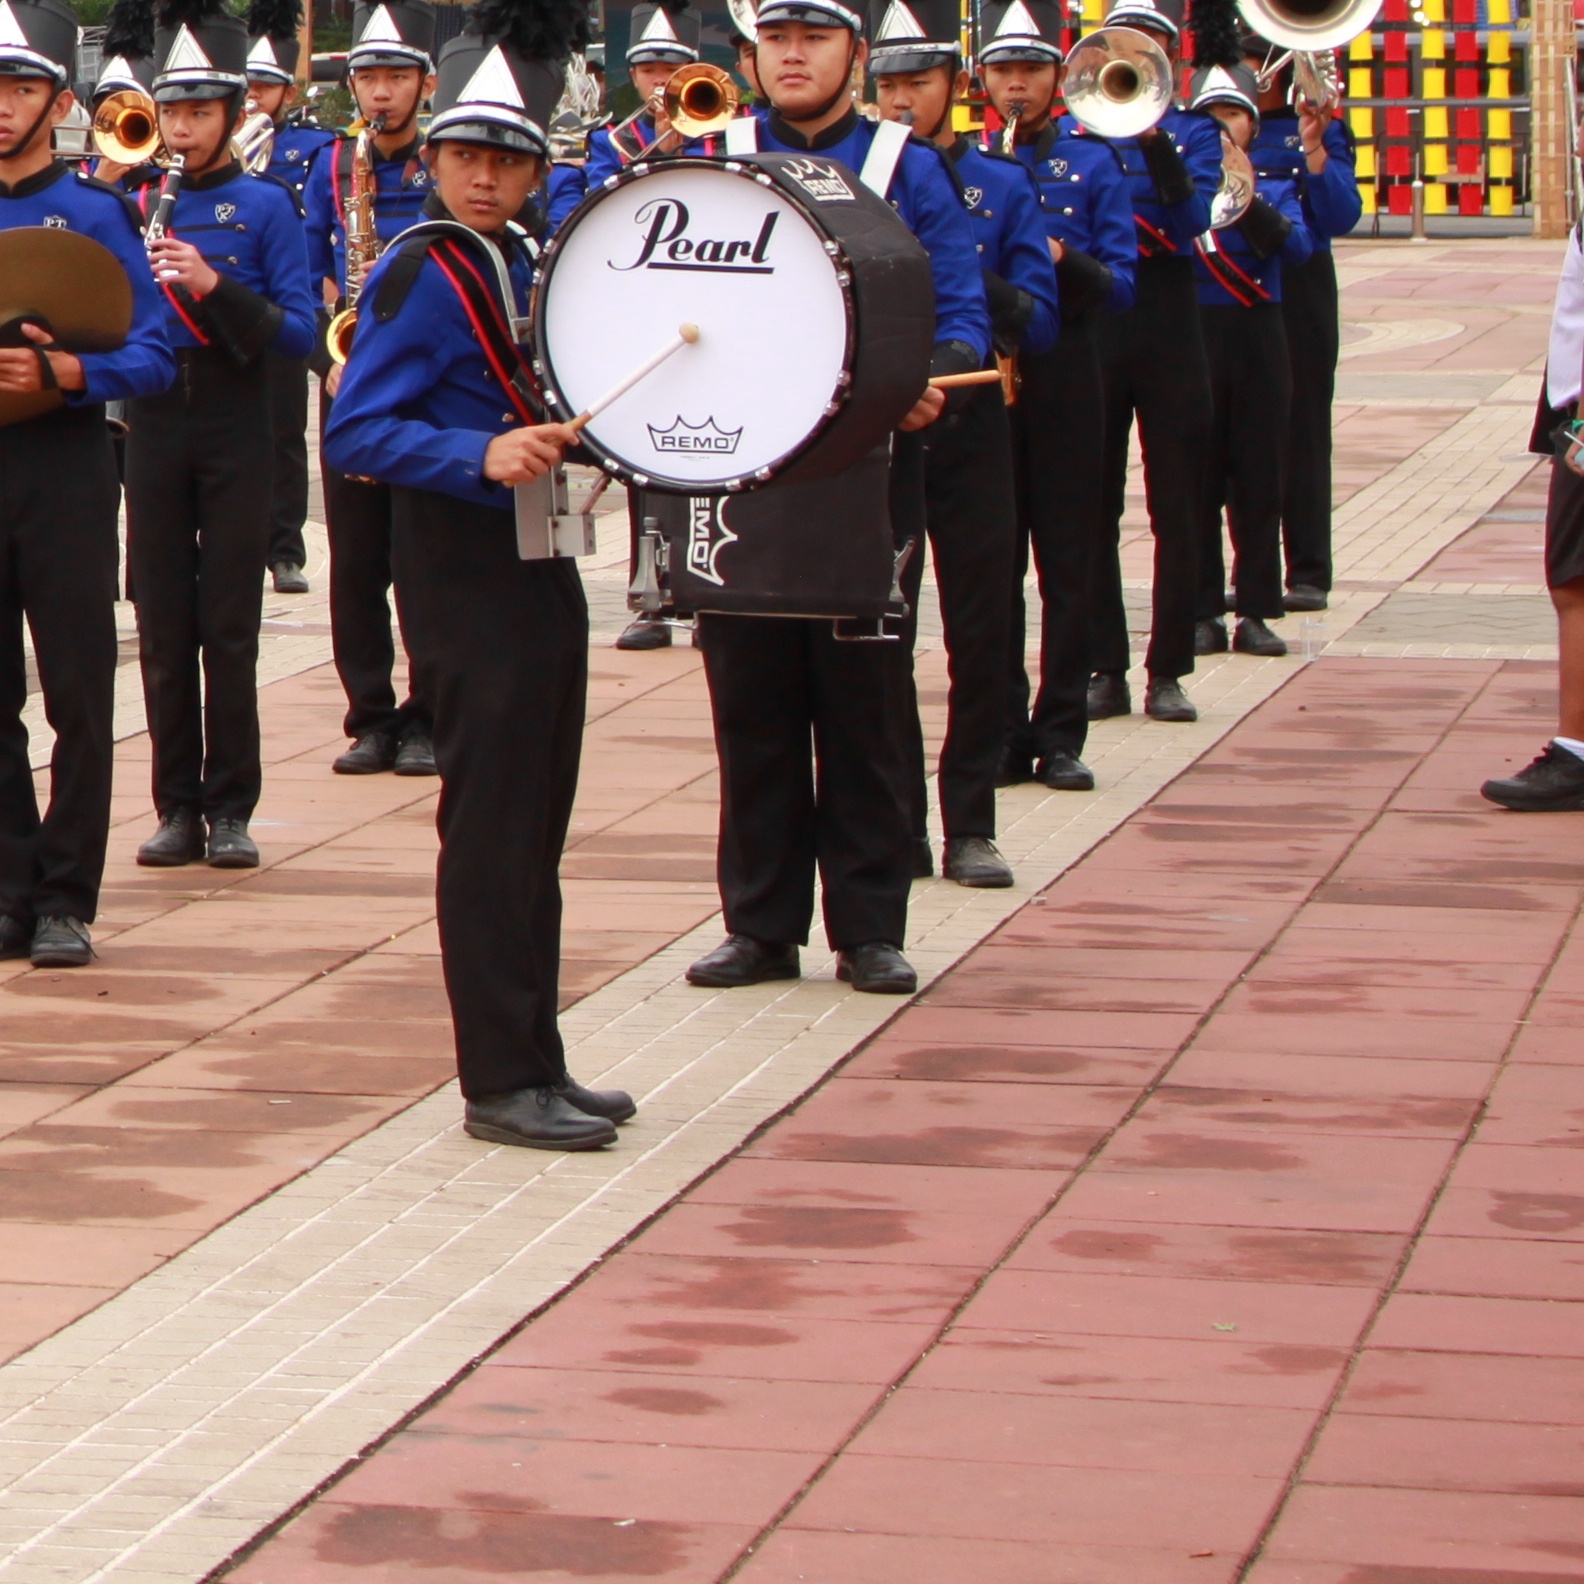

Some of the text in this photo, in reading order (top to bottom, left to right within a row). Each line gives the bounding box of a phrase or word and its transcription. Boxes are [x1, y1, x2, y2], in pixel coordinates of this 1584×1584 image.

[607, 198, 780, 271] Pearl
[661, 435, 729, 450] REMO
[693, 497, 711, 565] EMO
